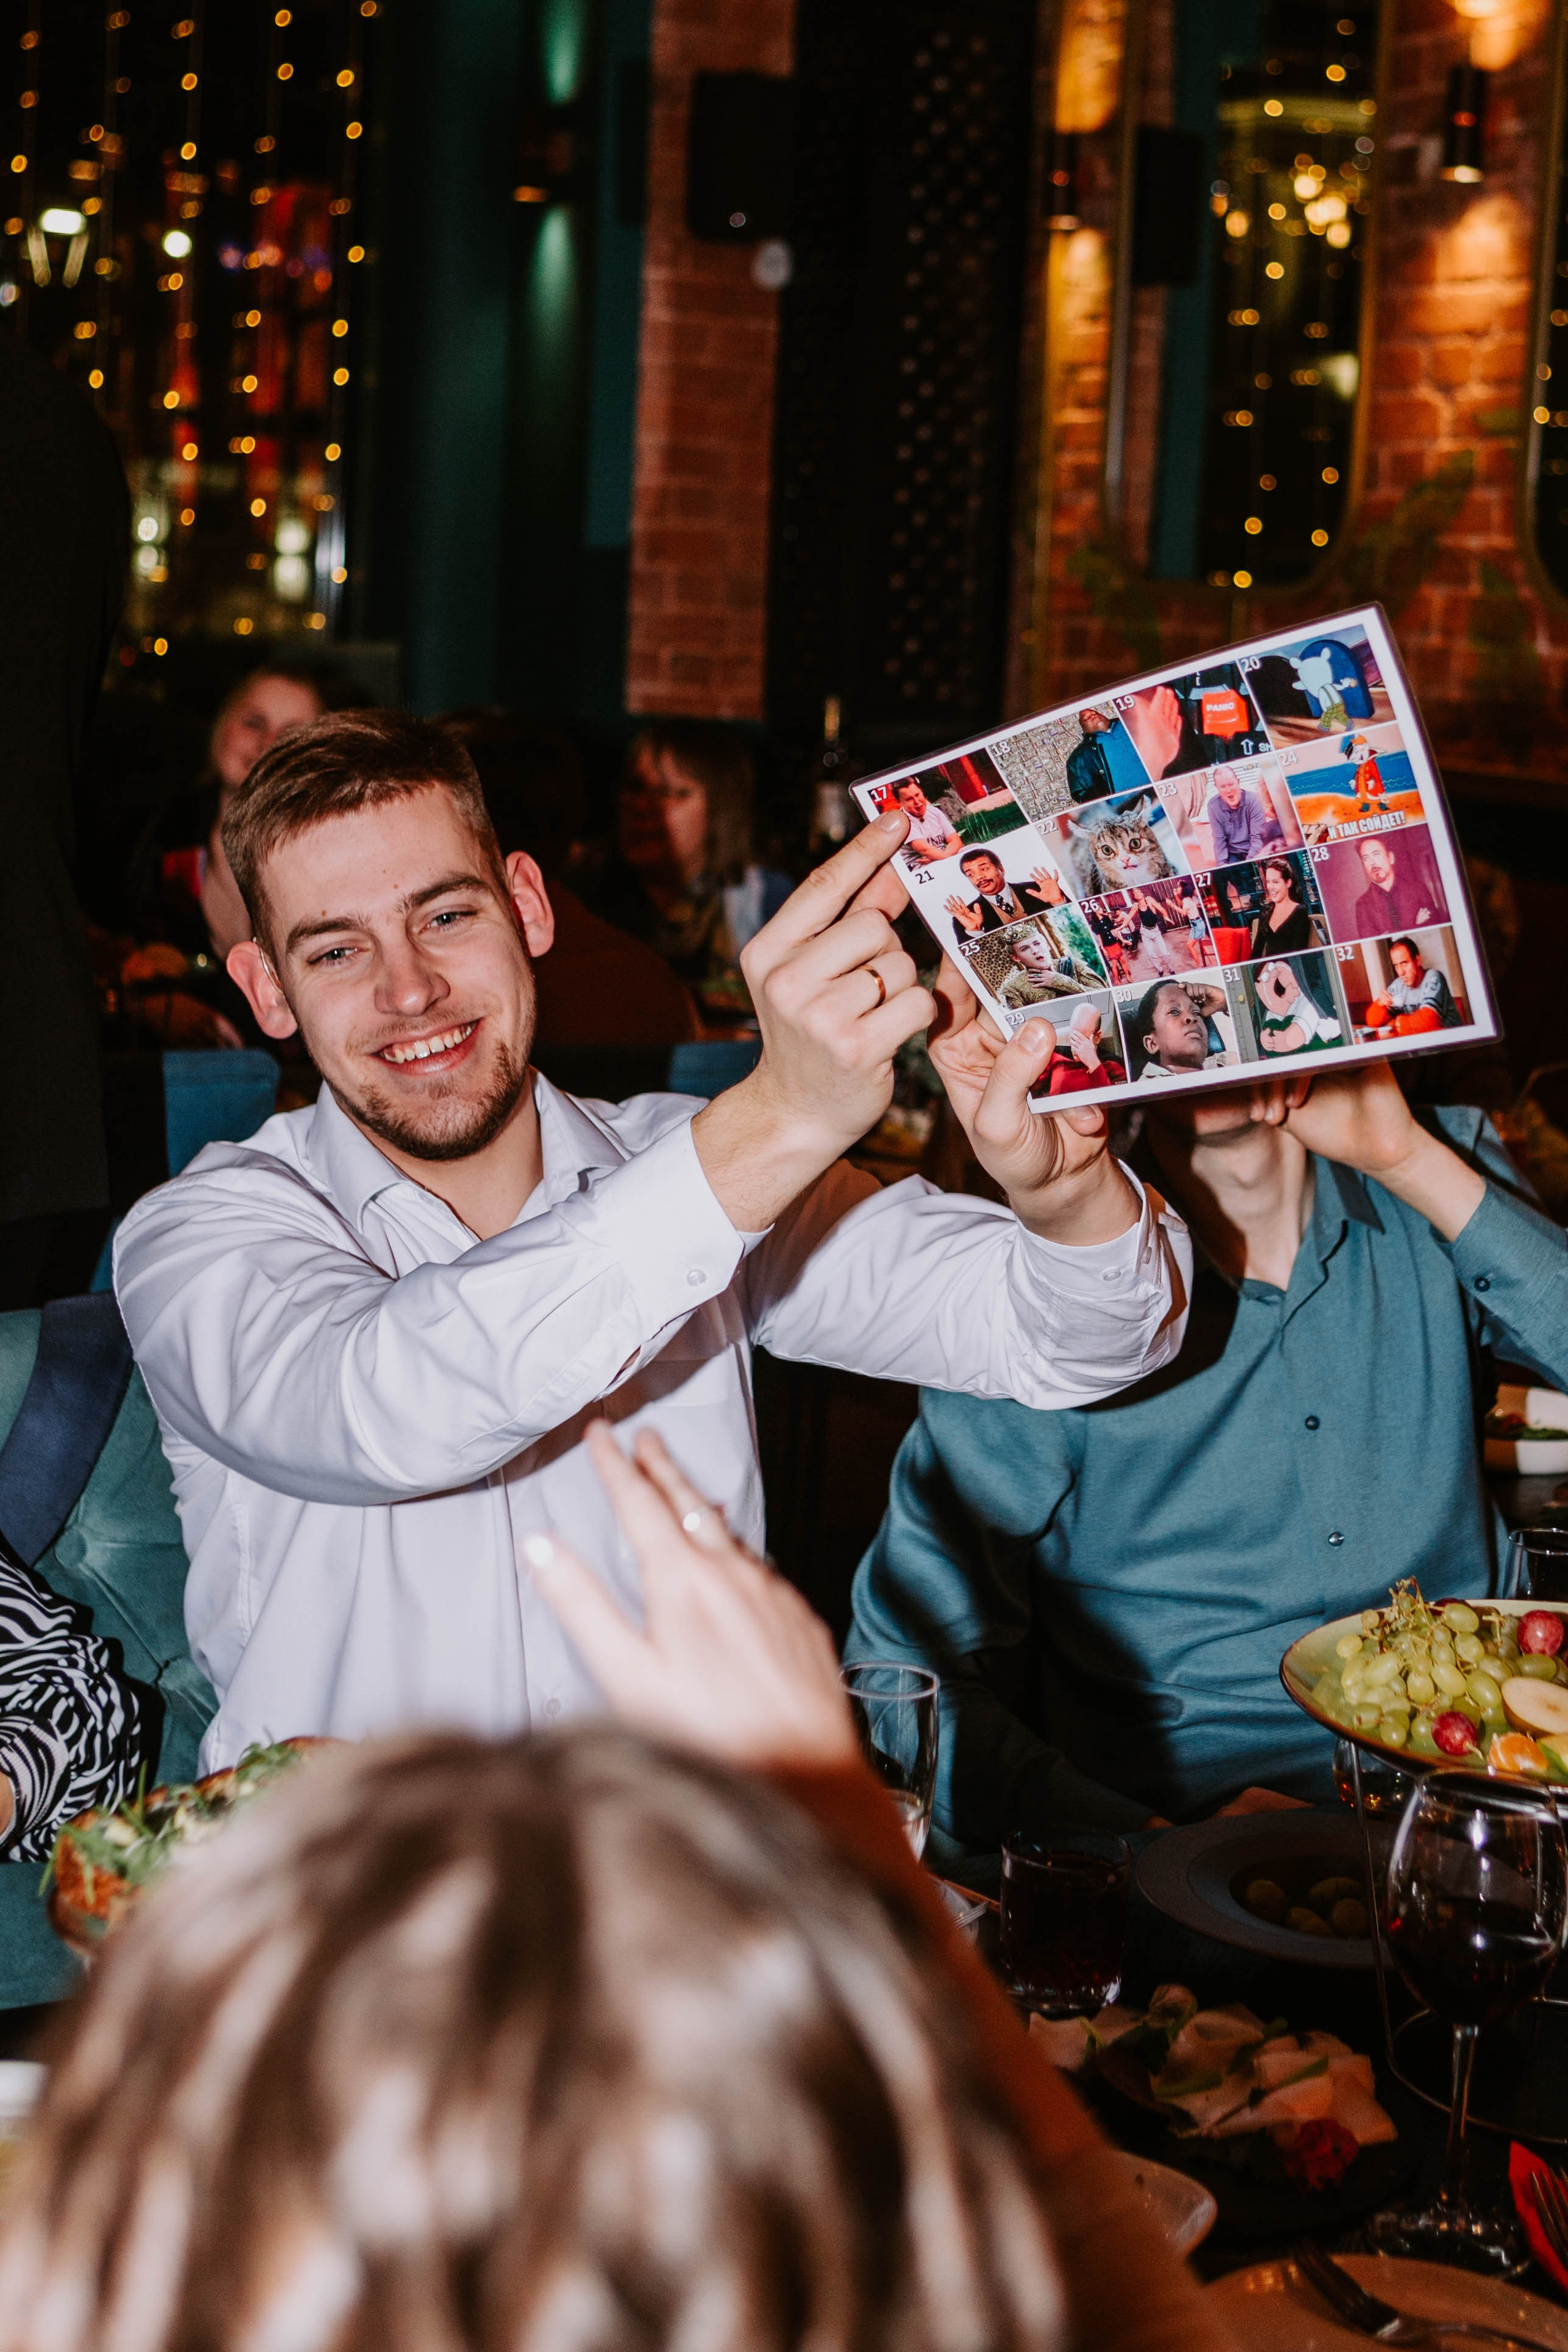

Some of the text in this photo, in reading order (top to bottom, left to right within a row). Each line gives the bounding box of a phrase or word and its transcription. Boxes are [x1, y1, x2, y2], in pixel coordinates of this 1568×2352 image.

[1241, 657, 1261, 672] 20
[1115, 695, 1135, 710] 19
[1206, 702, 1235, 711] PANIC
[992, 742, 1011, 756] 18
[1280, 750, 1298, 766] 24
[870, 786, 888, 802] 17
[1160, 783, 1177, 797] 23
[1039, 821, 1058, 835] 22
[1328, 826, 1337, 839] И
[1336, 821, 1359, 837] ТАК
[1311, 846, 1330, 862] 28
[916, 870, 934, 884] 21
[1195, 872, 1212, 888] 27
[1081, 899, 1099, 913] 26
[961, 941, 980, 956] 25
[1336, 946, 1354, 962] 32
[1224, 968, 1241, 982] 31
[1115, 989, 1132, 1003] 30
[1008, 1012, 1025, 1025] 29
